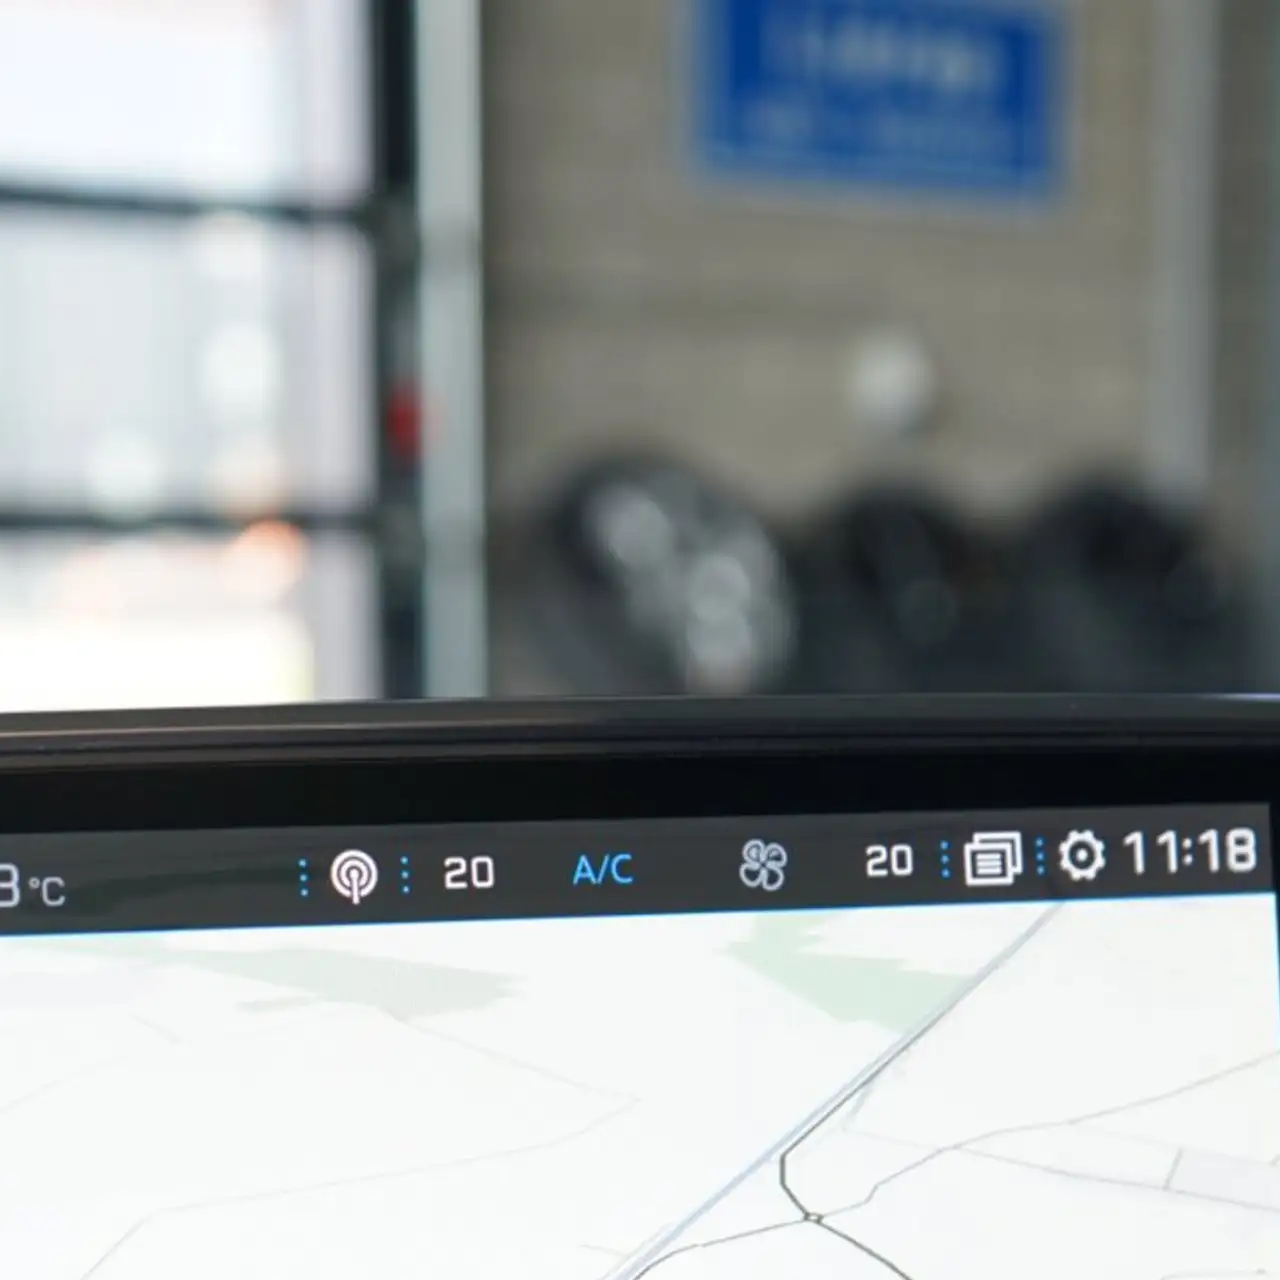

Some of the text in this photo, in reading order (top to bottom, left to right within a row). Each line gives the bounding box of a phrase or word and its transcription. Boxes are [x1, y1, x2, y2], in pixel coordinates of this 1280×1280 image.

[865, 844, 914, 878] 20
[1123, 828, 1257, 875] 11:18
[443, 856, 495, 890] 20
[572, 853, 634, 886] A/C
